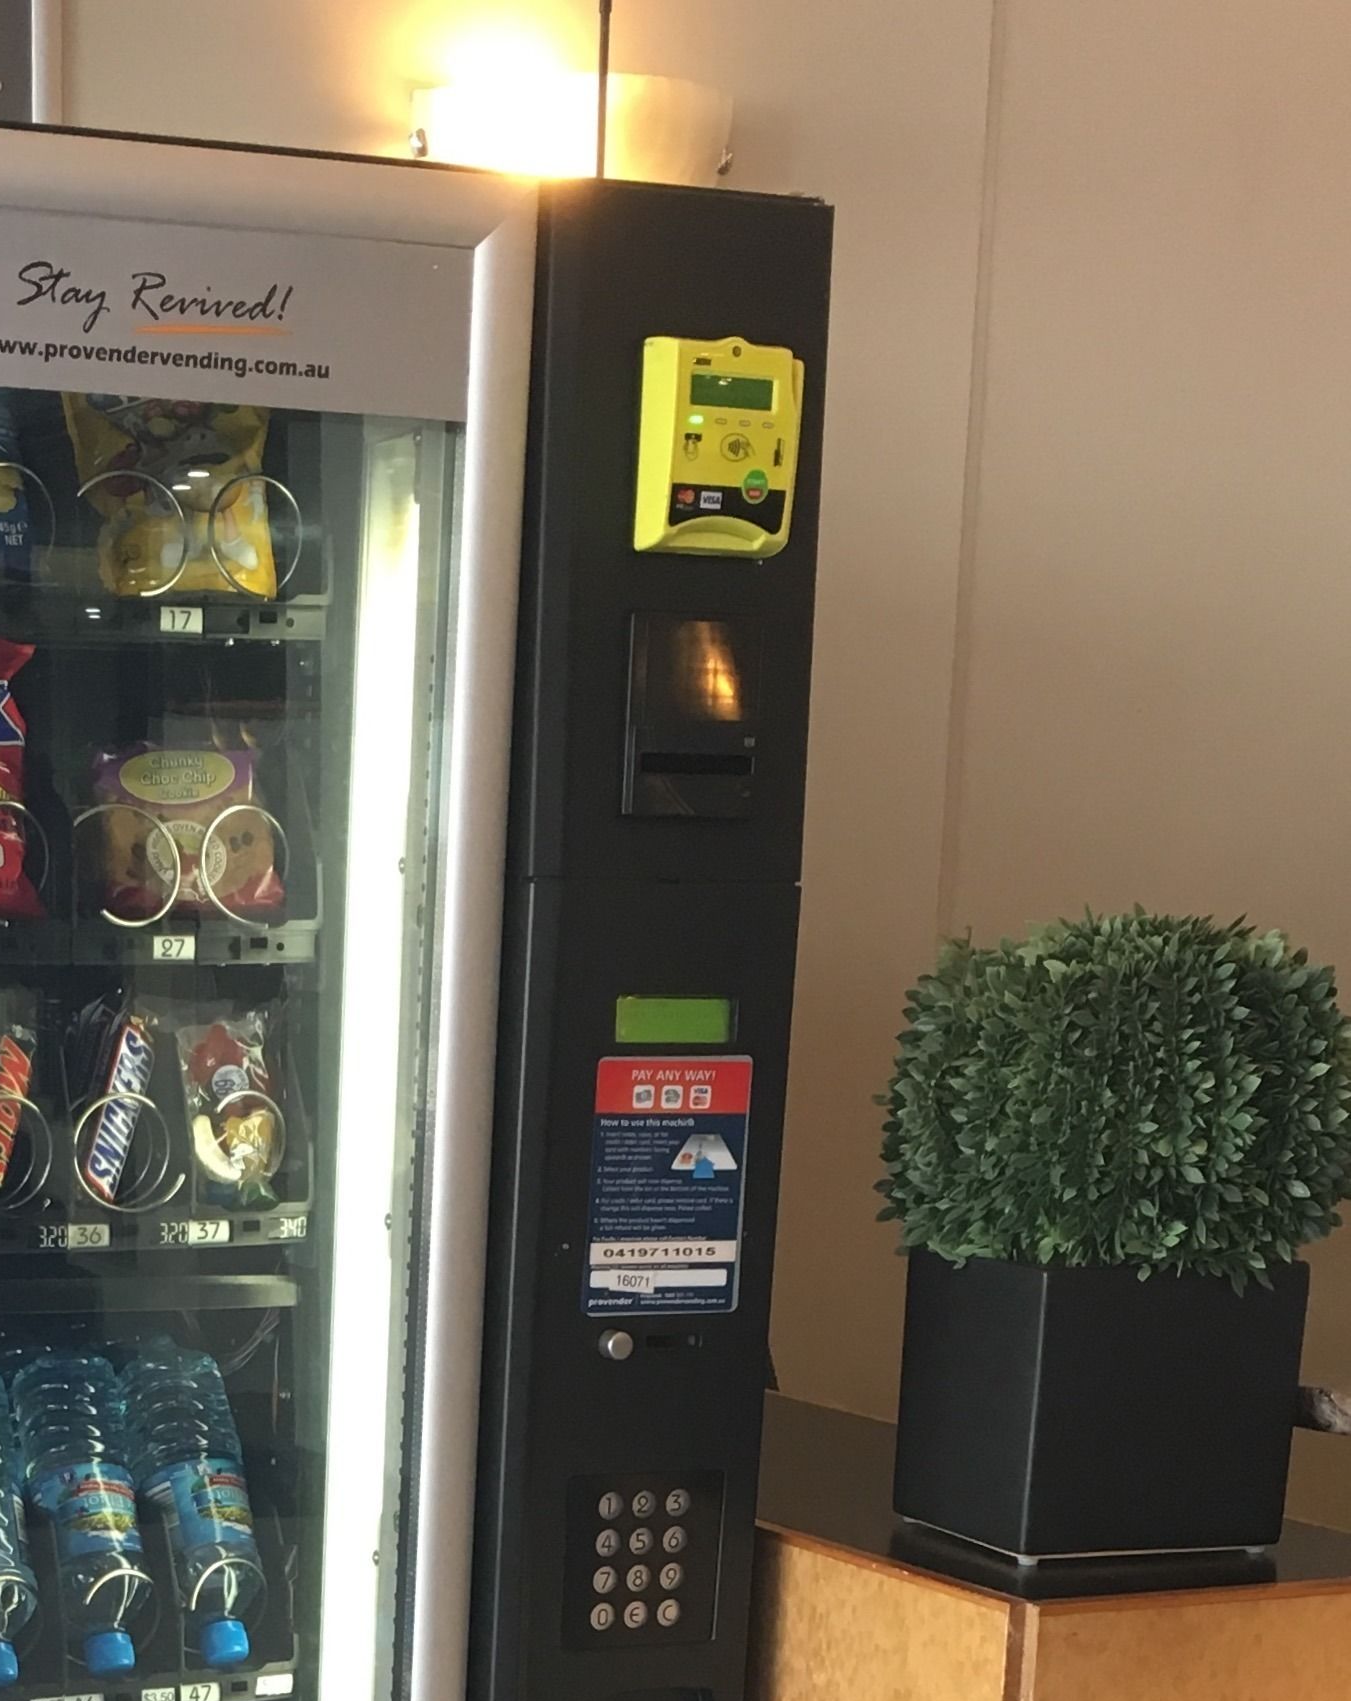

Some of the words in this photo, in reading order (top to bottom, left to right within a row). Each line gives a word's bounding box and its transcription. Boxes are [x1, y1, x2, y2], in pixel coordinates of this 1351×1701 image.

[16, 260, 111, 334] Stay
[131, 271, 295, 323] Revived!
[4, 533, 24, 546] NET
[169, 610, 191, 630] 17
[150, 756, 204, 770] Chunky
[182, 771, 216, 788] Chip
[161, 937, 186, 957] 27
[631, 1069, 654, 1081] PAY
[656, 1069, 682, 1081] ANY
[684, 1069, 717, 1081] WAY!
[600, 1119, 619, 1127] How
[620, 1119, 630, 1127] to
[631, 1119, 645, 1127] use
[76, 1224, 103, 1244] 36
[196, 1220, 221, 1240] 37
[602, 1246, 717, 1258] 0419711015
[616, 1274, 651, 1288] 16071
[605, 1497, 613, 1515] 1
[637, 1496, 649, 1514] 2
[670, 1494, 682, 1512] 3
[601, 1534, 613, 1552] 4
[634, 1533, 646, 1551] 5
[667, 1531, 679, 1548] 6
[600, 1571, 611, 1589] 7
[632, 1570, 643, 1587] 8
[666, 1568, 677, 1586] 9
[598, 1609, 607, 1626] 0
[662, 1605, 672, 1622] C
